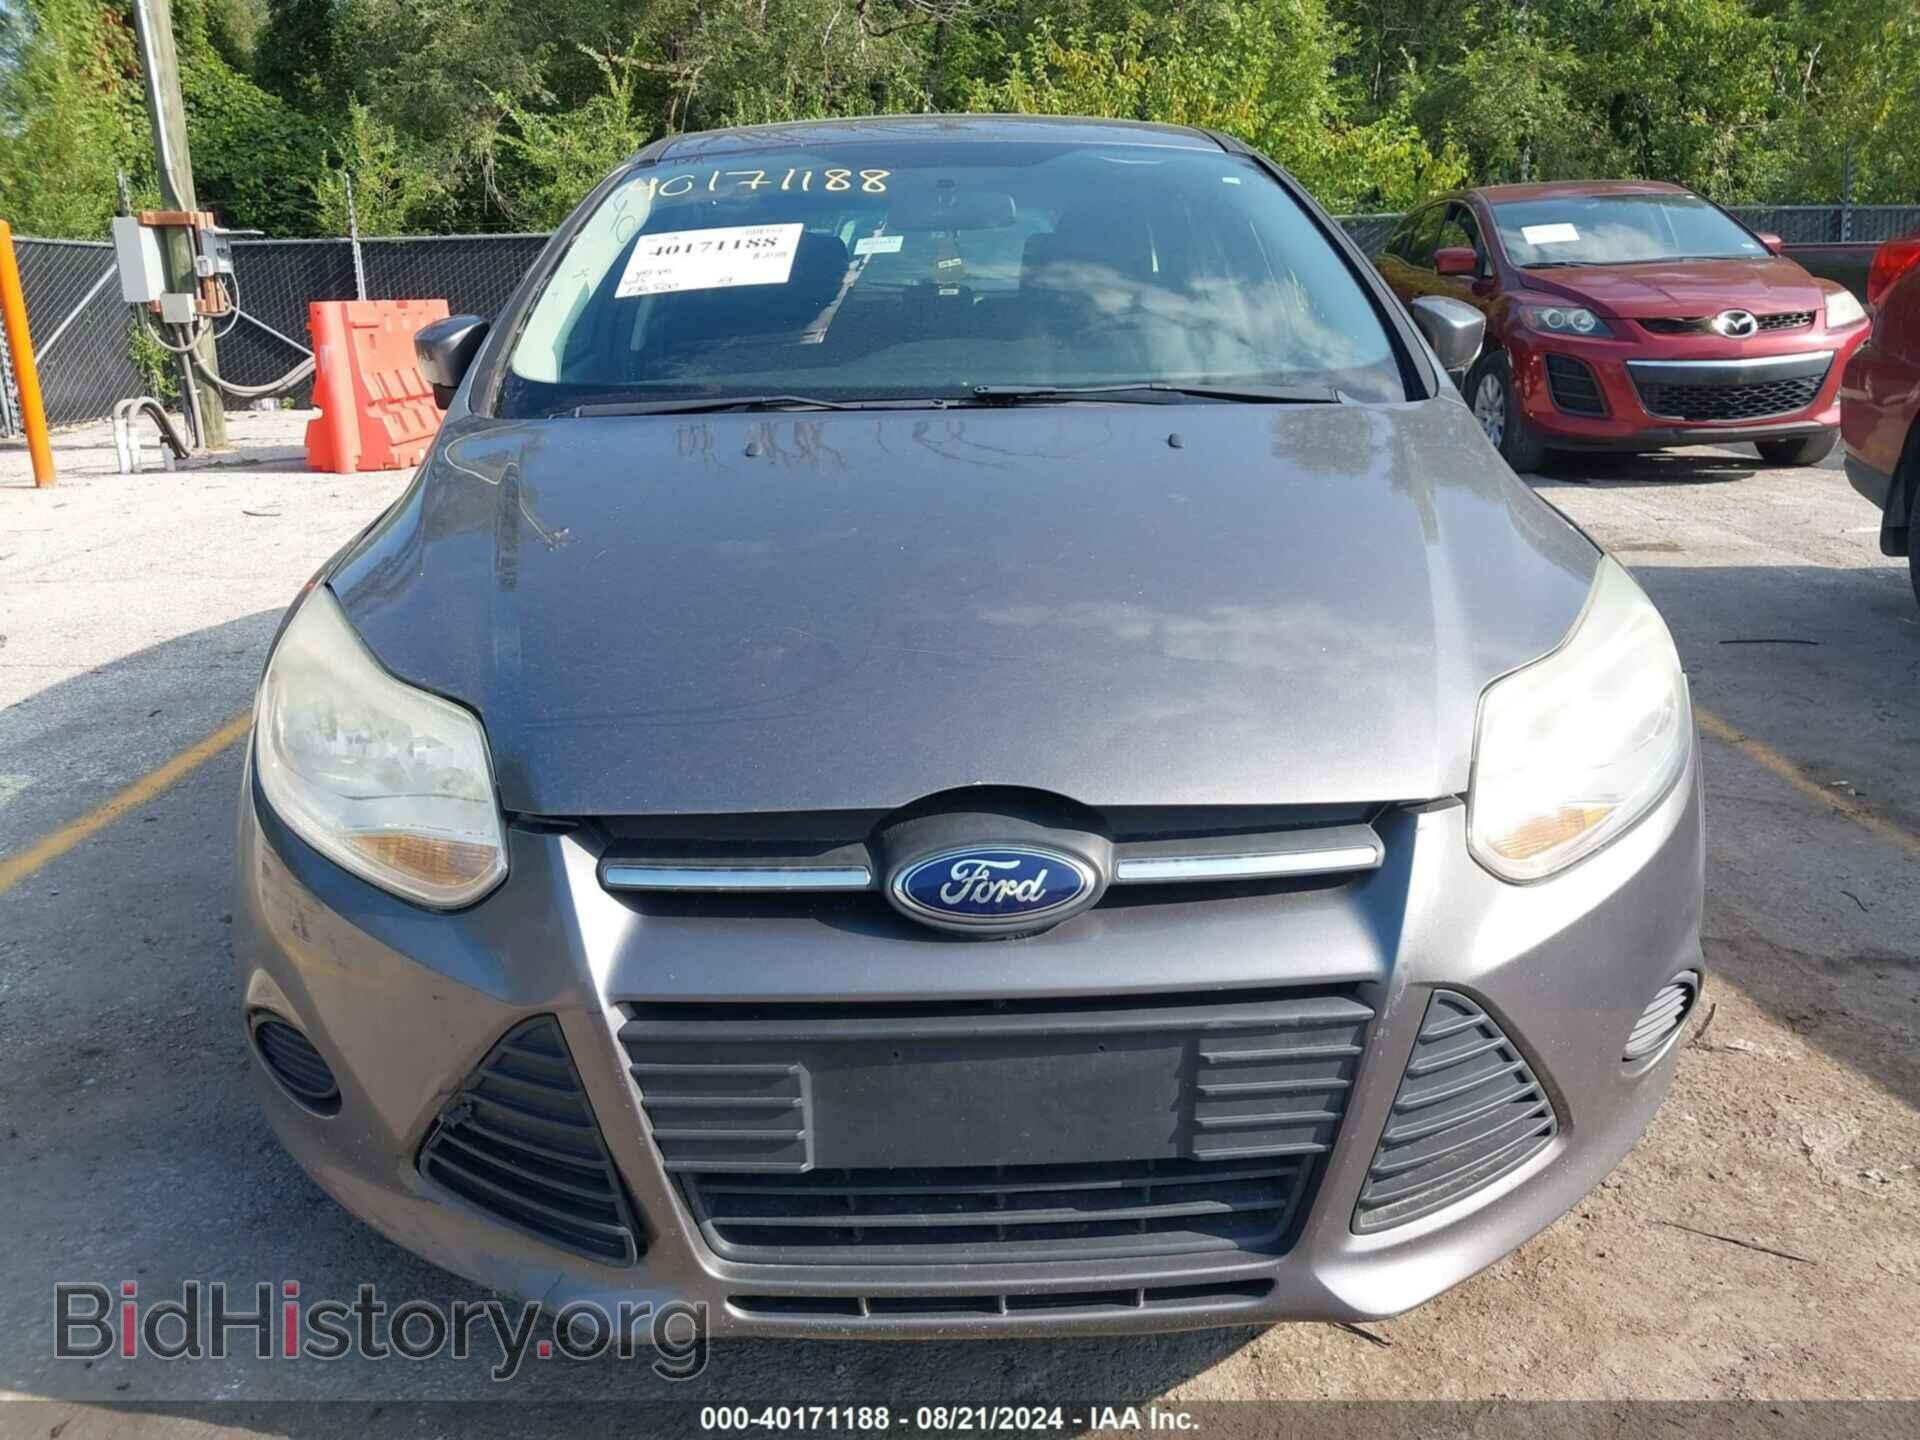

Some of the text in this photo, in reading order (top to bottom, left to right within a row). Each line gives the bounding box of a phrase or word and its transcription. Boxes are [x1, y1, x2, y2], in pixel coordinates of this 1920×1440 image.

[628, 168, 892, 201] 40171188
[648, 237, 778, 256] 40171188
[940, 858, 1048, 905] Ford
